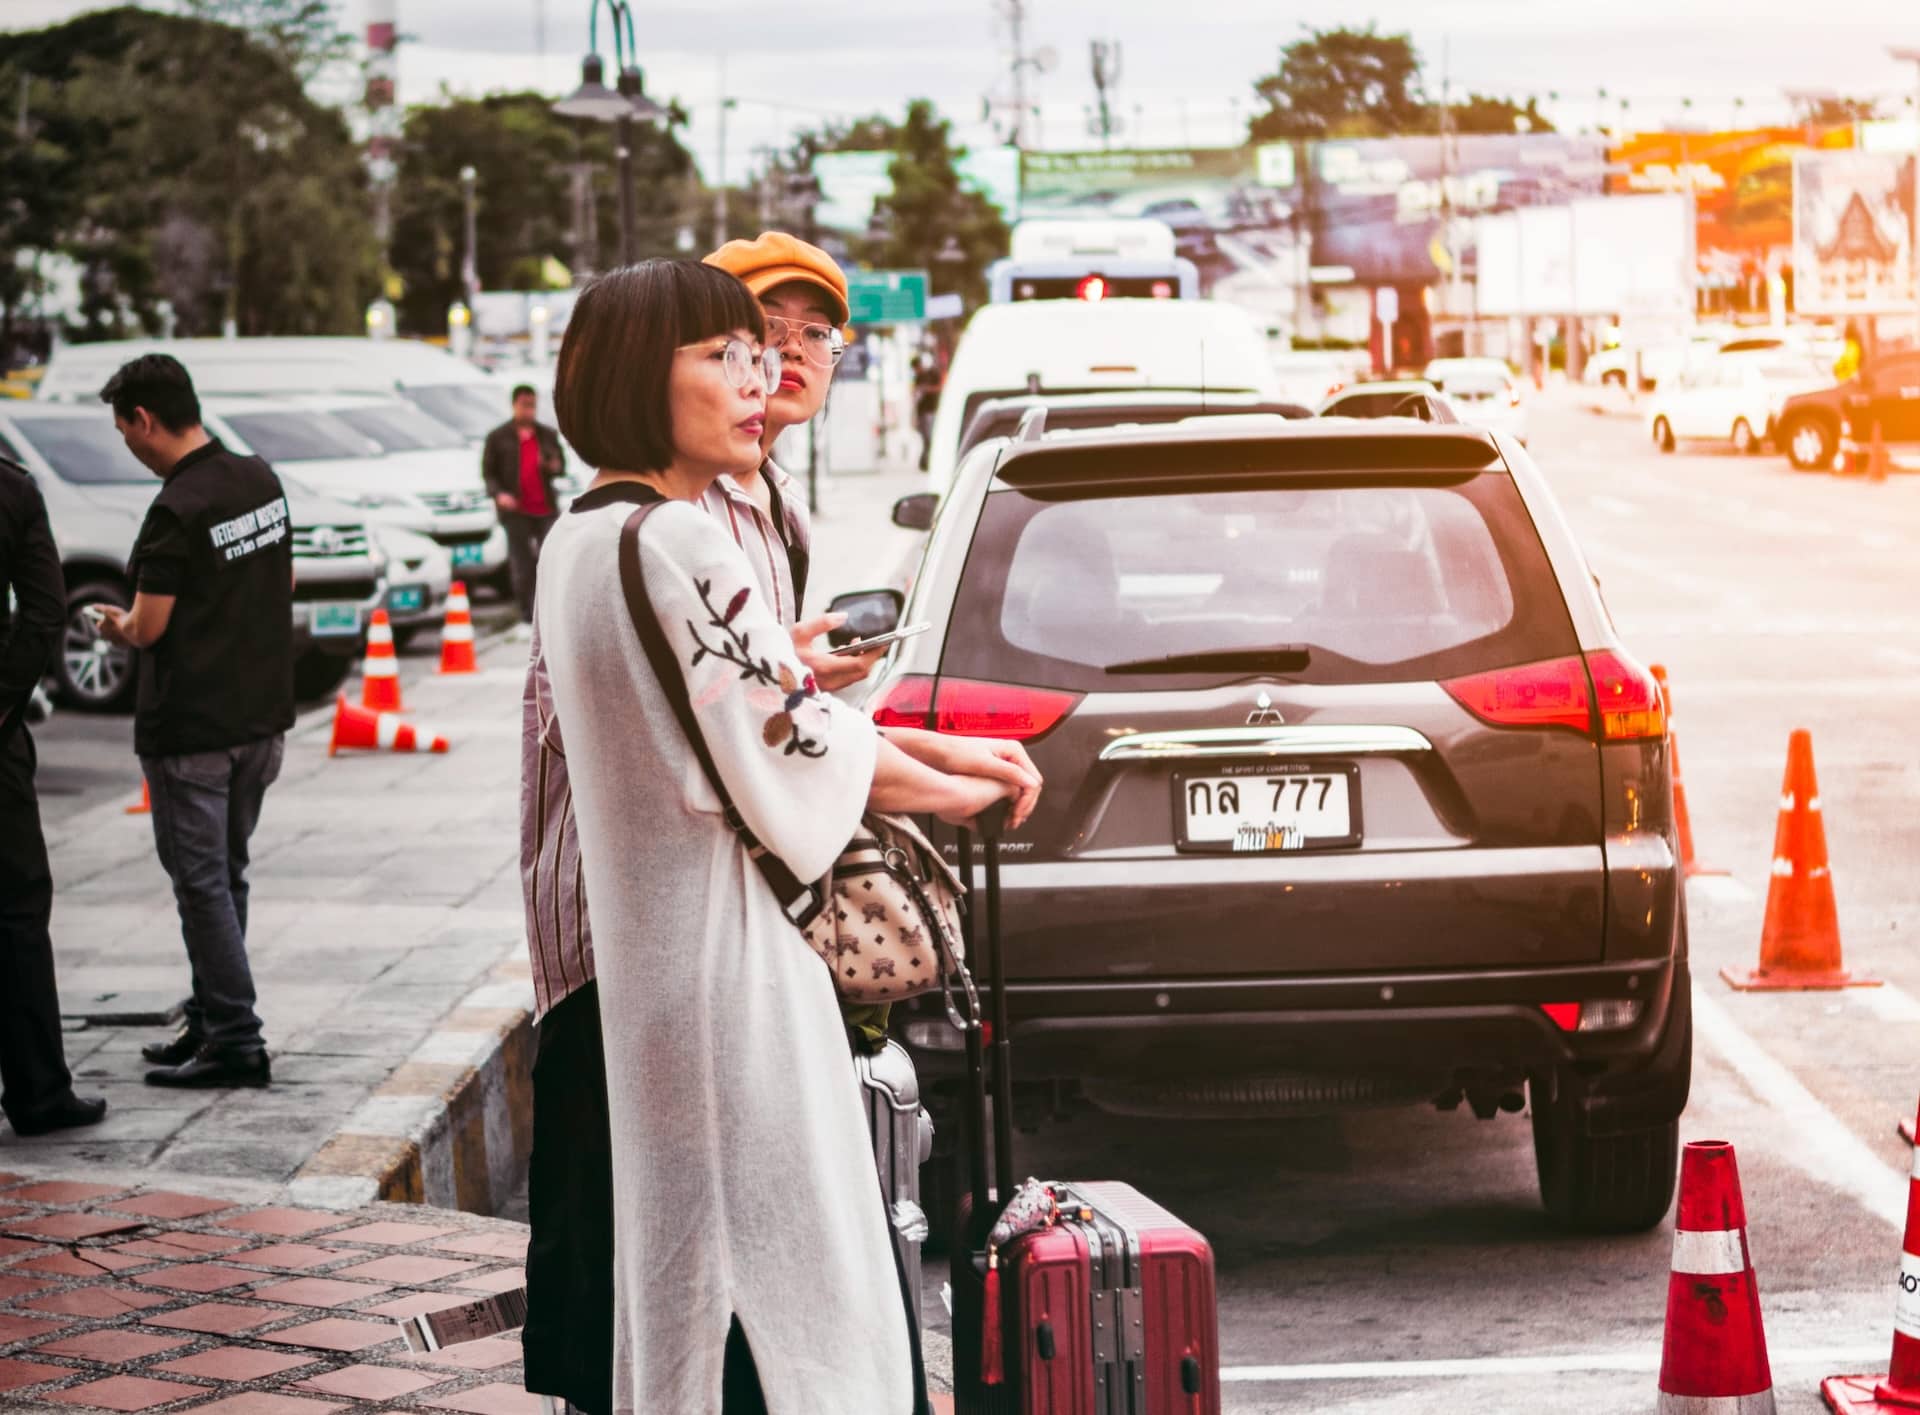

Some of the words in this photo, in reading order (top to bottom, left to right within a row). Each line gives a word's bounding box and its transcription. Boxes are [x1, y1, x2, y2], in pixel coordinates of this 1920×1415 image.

[210, 511, 259, 548] VETERINARY
[1188, 781, 1239, 815] กล
[1267, 778, 1332, 812] 777
[997, 842, 1034, 853] PORT
[1899, 1272, 1920, 1293] AO
